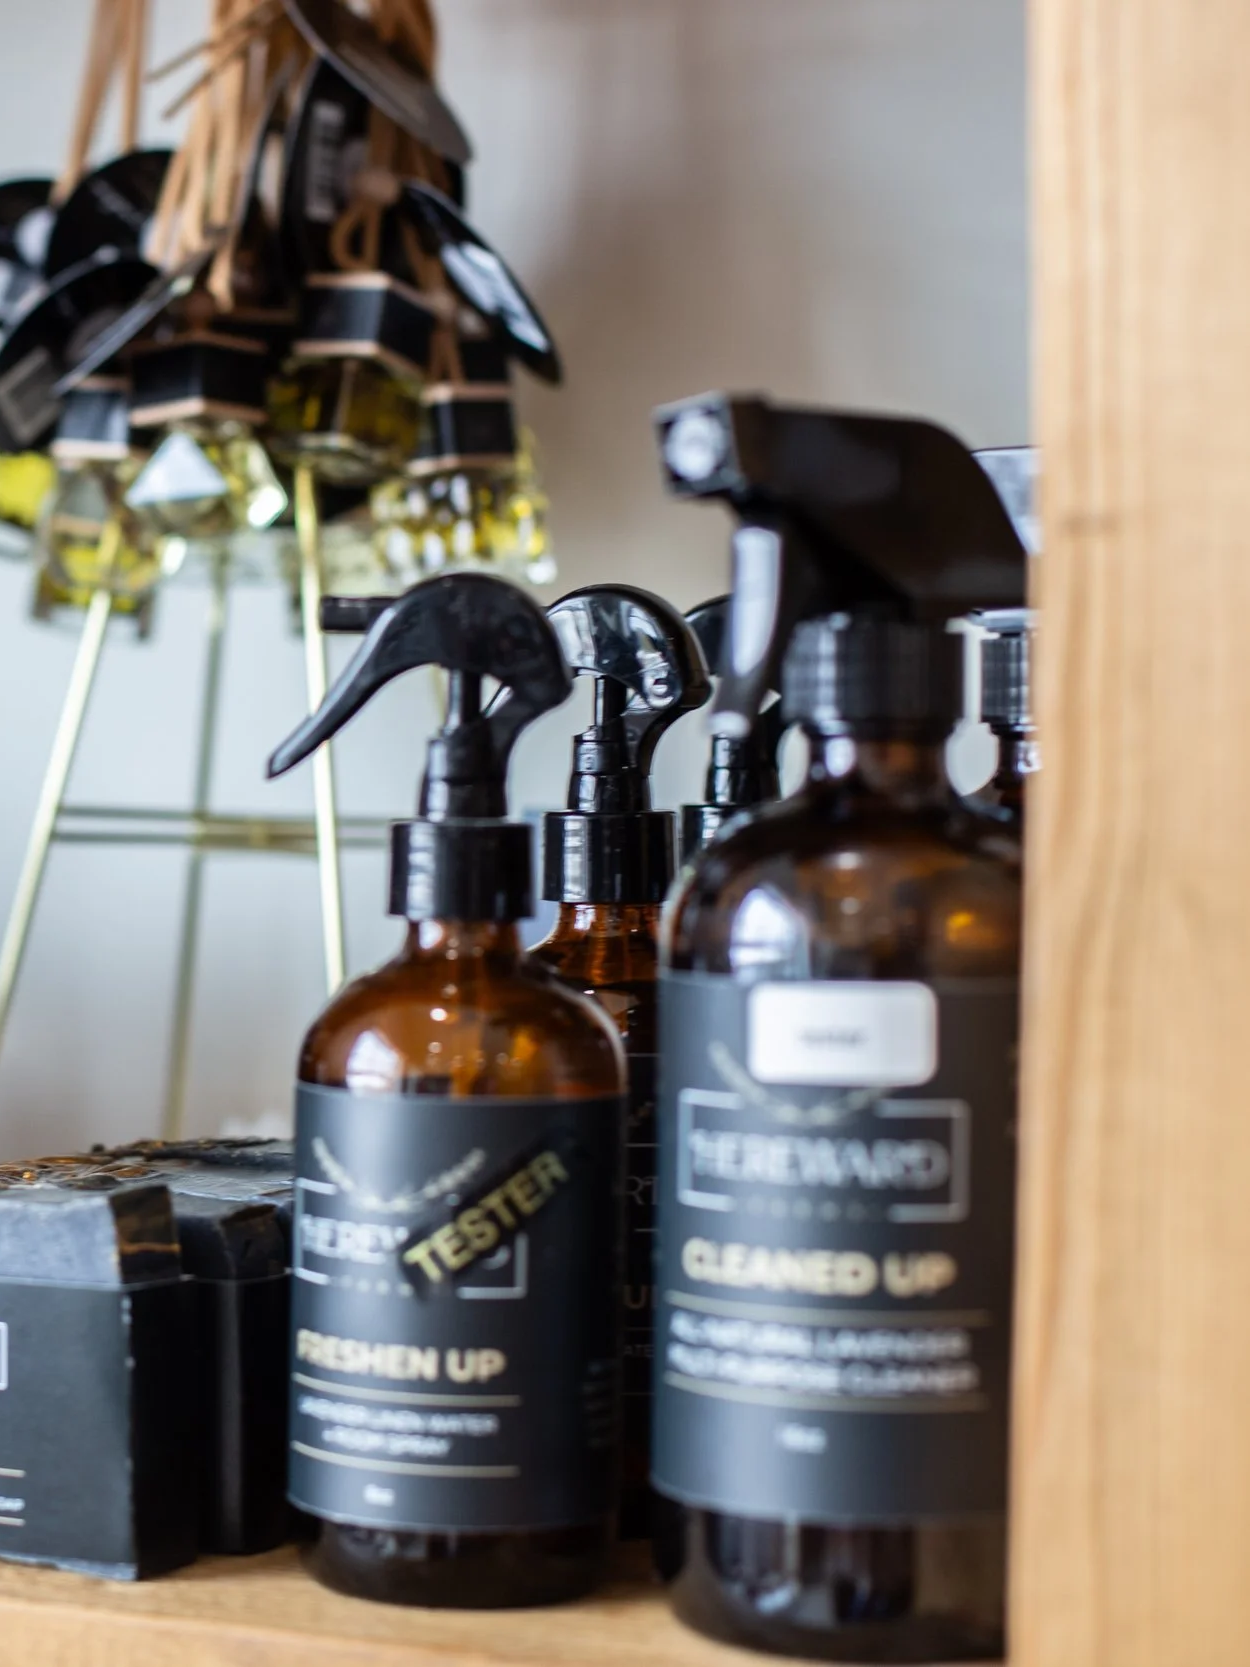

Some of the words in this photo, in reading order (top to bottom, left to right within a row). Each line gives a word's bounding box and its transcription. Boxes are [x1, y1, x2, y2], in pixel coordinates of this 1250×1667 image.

[403, 1150, 569, 1284] TESTER
[682, 1237, 878, 1297] CLEANED
[883, 1251, 957, 1298] UP
[297, 1328, 439, 1382] FRESHEN
[446, 1348, 507, 1384] UP
